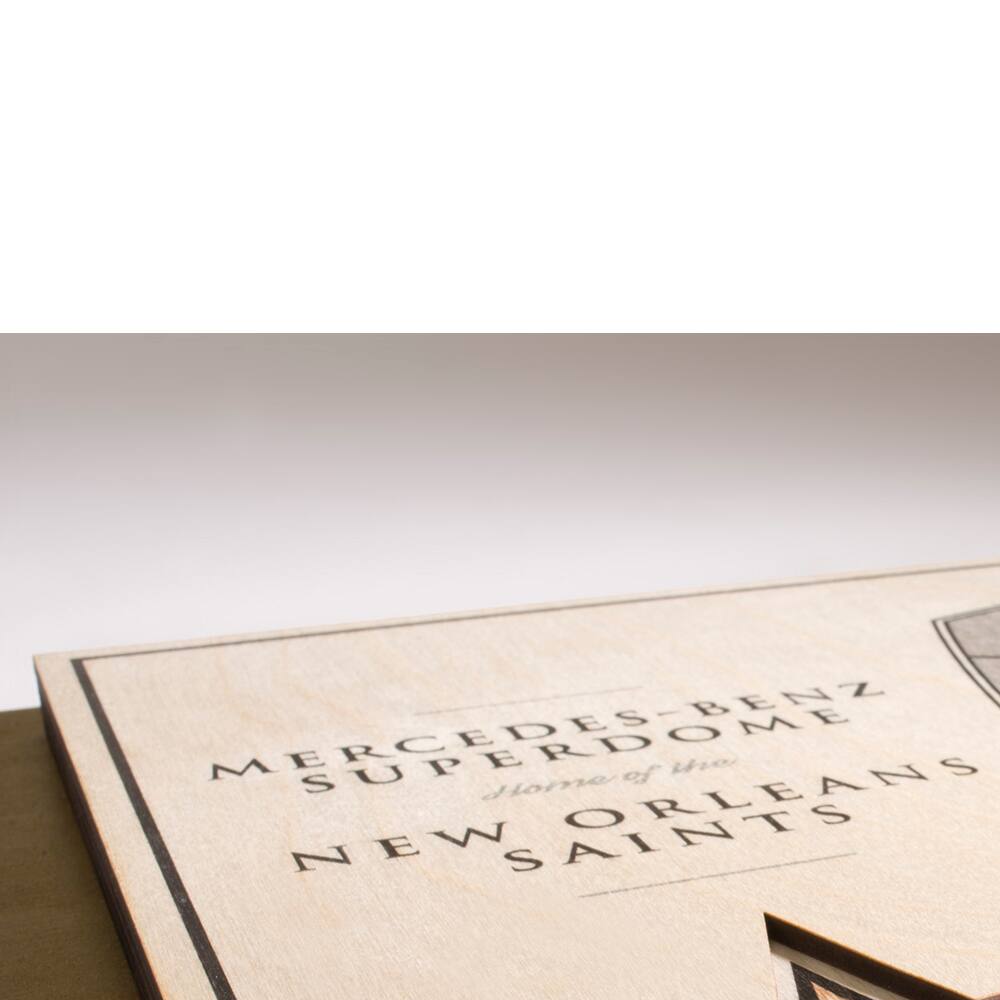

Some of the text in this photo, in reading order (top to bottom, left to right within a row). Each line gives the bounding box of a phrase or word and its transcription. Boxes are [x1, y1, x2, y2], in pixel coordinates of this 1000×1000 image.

[209, 681, 887, 782] MERCEDES-BENZ
[301, 708, 851, 795] SUPERDOME
[290, 756, 980, 873] NEW ORLEANS
[481, 757, 738, 801] Home of the
[503, 803, 853, 873] SAINTS
